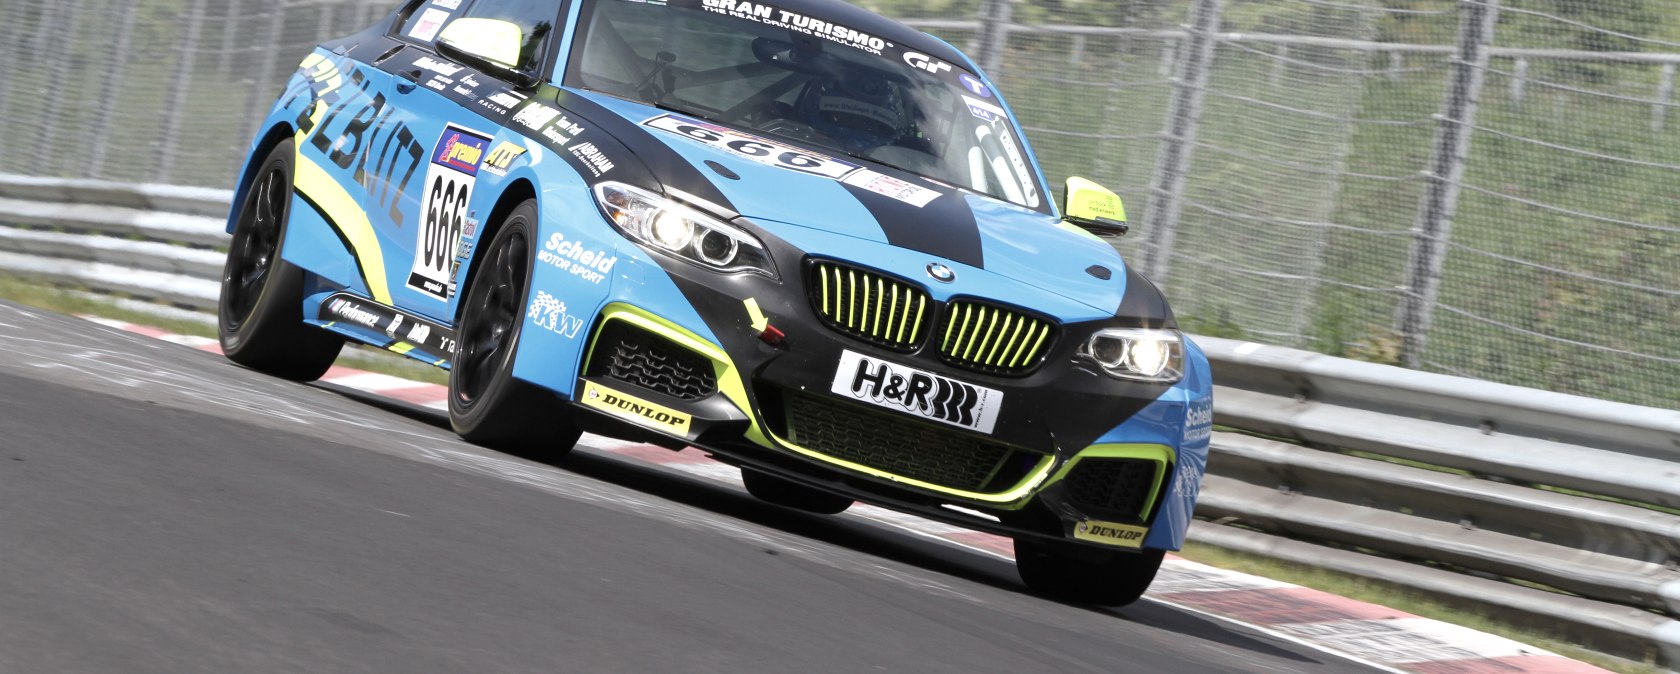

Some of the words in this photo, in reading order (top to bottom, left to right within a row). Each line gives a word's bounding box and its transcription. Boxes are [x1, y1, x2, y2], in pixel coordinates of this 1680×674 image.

[702, 5, 726, 14] THE
[729, 11, 761, 22] REAL
[763, 18, 812, 34] DRIVING
[814, 31, 881, 55] SIMULATOR
[703, 0, 772, 18] GRAN
[779, 10, 884, 50] TURISMO
[963, 76, 984, 95] T
[478, 99, 507, 115] RACING
[449, 139, 482, 166] premio
[484, 141, 528, 169] ATS
[676, 125, 826, 168] 666
[424, 174, 468, 273] 666
[537, 249, 571, 271] MOTOR
[570, 264, 605, 285] SPORT
[545, 232, 617, 274] Scheid
[851, 358, 935, 416] H&R
[602, 394, 685, 425] DUNLOP
[1089, 525, 1143, 541] DUNLOP
